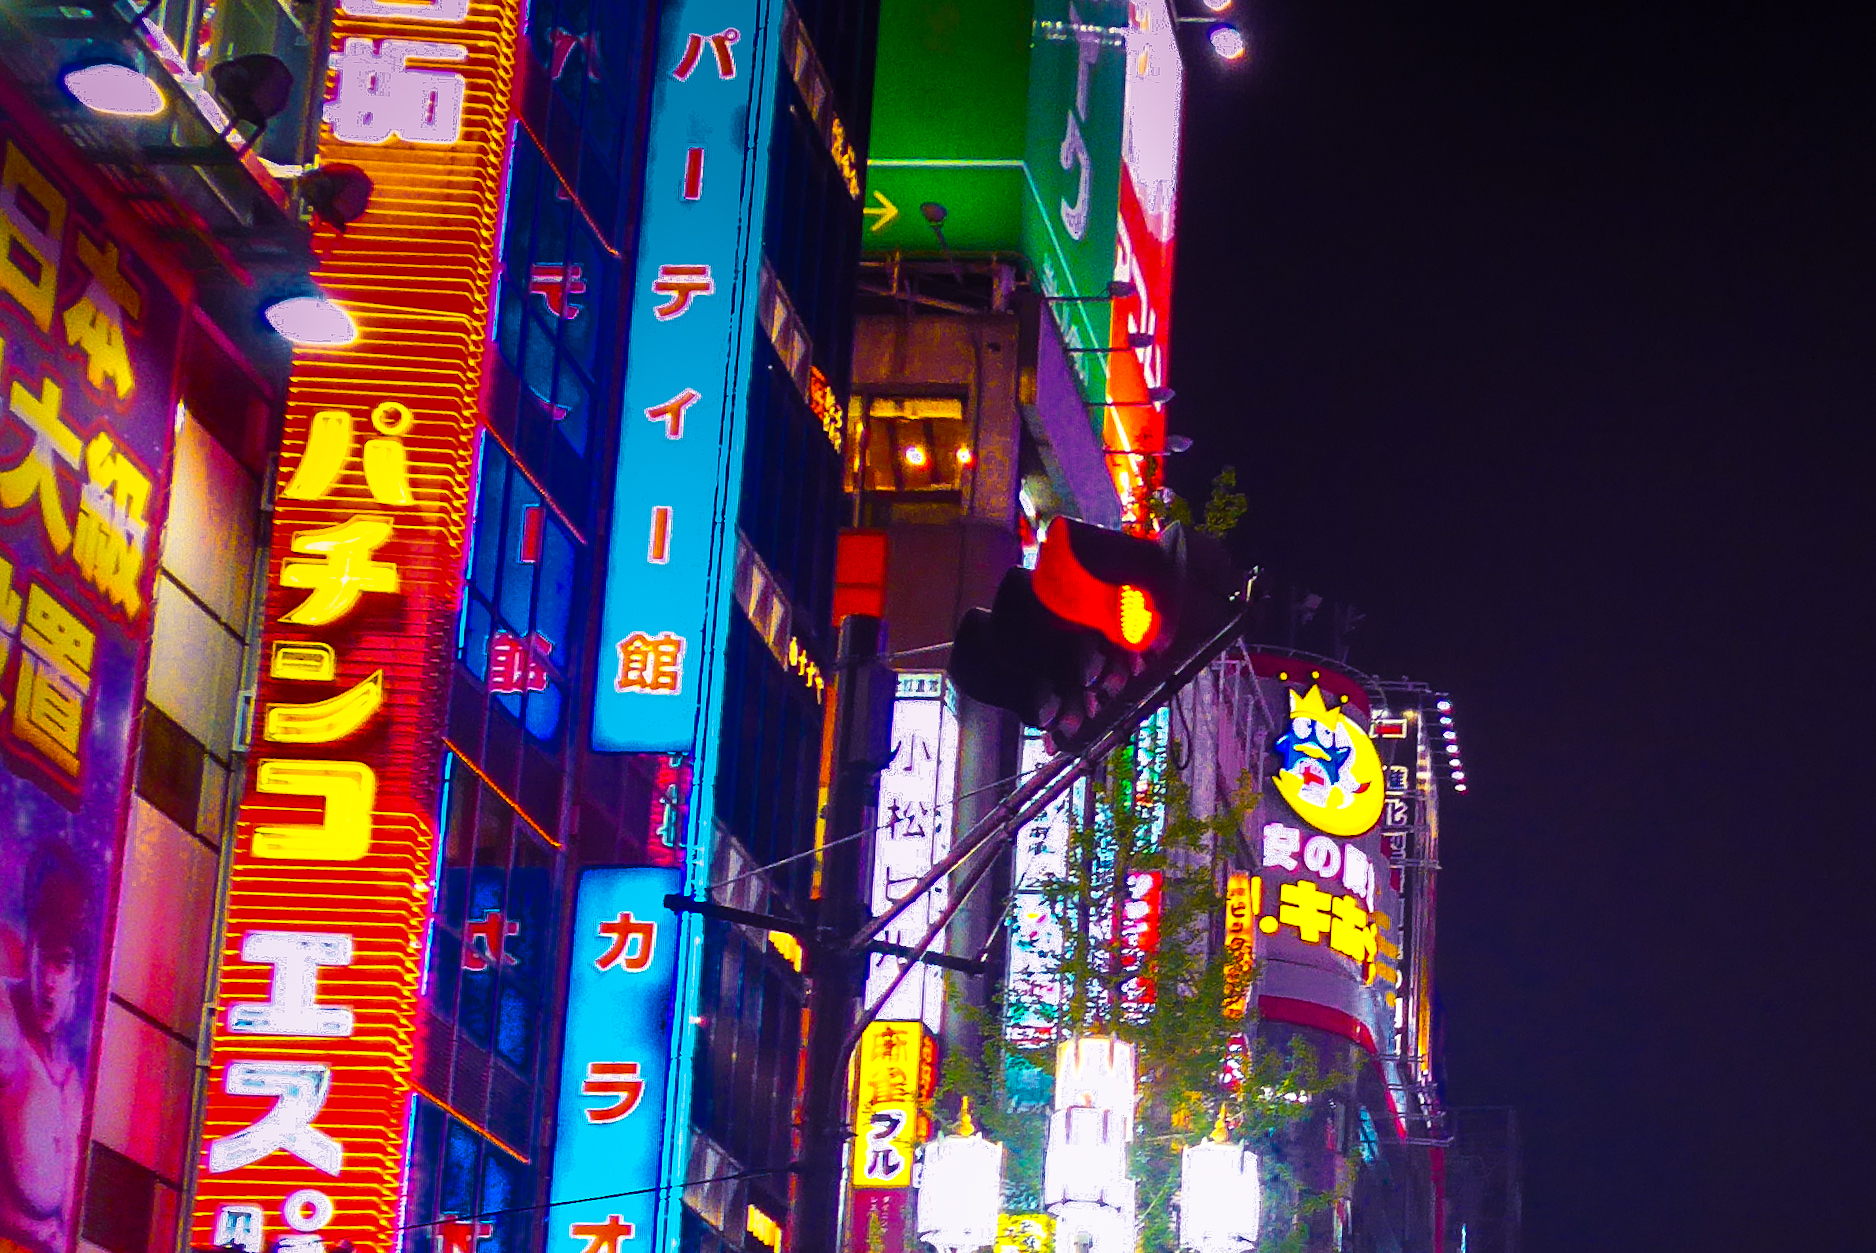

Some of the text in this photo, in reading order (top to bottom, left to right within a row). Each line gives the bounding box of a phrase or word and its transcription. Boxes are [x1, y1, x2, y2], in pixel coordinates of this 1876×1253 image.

[321, 0, 468, 143] 拓
[0, 376, 151, 621] 大級
[613, 28, 740, 695] パーティー館
[252, 402, 412, 861] パチンコ
